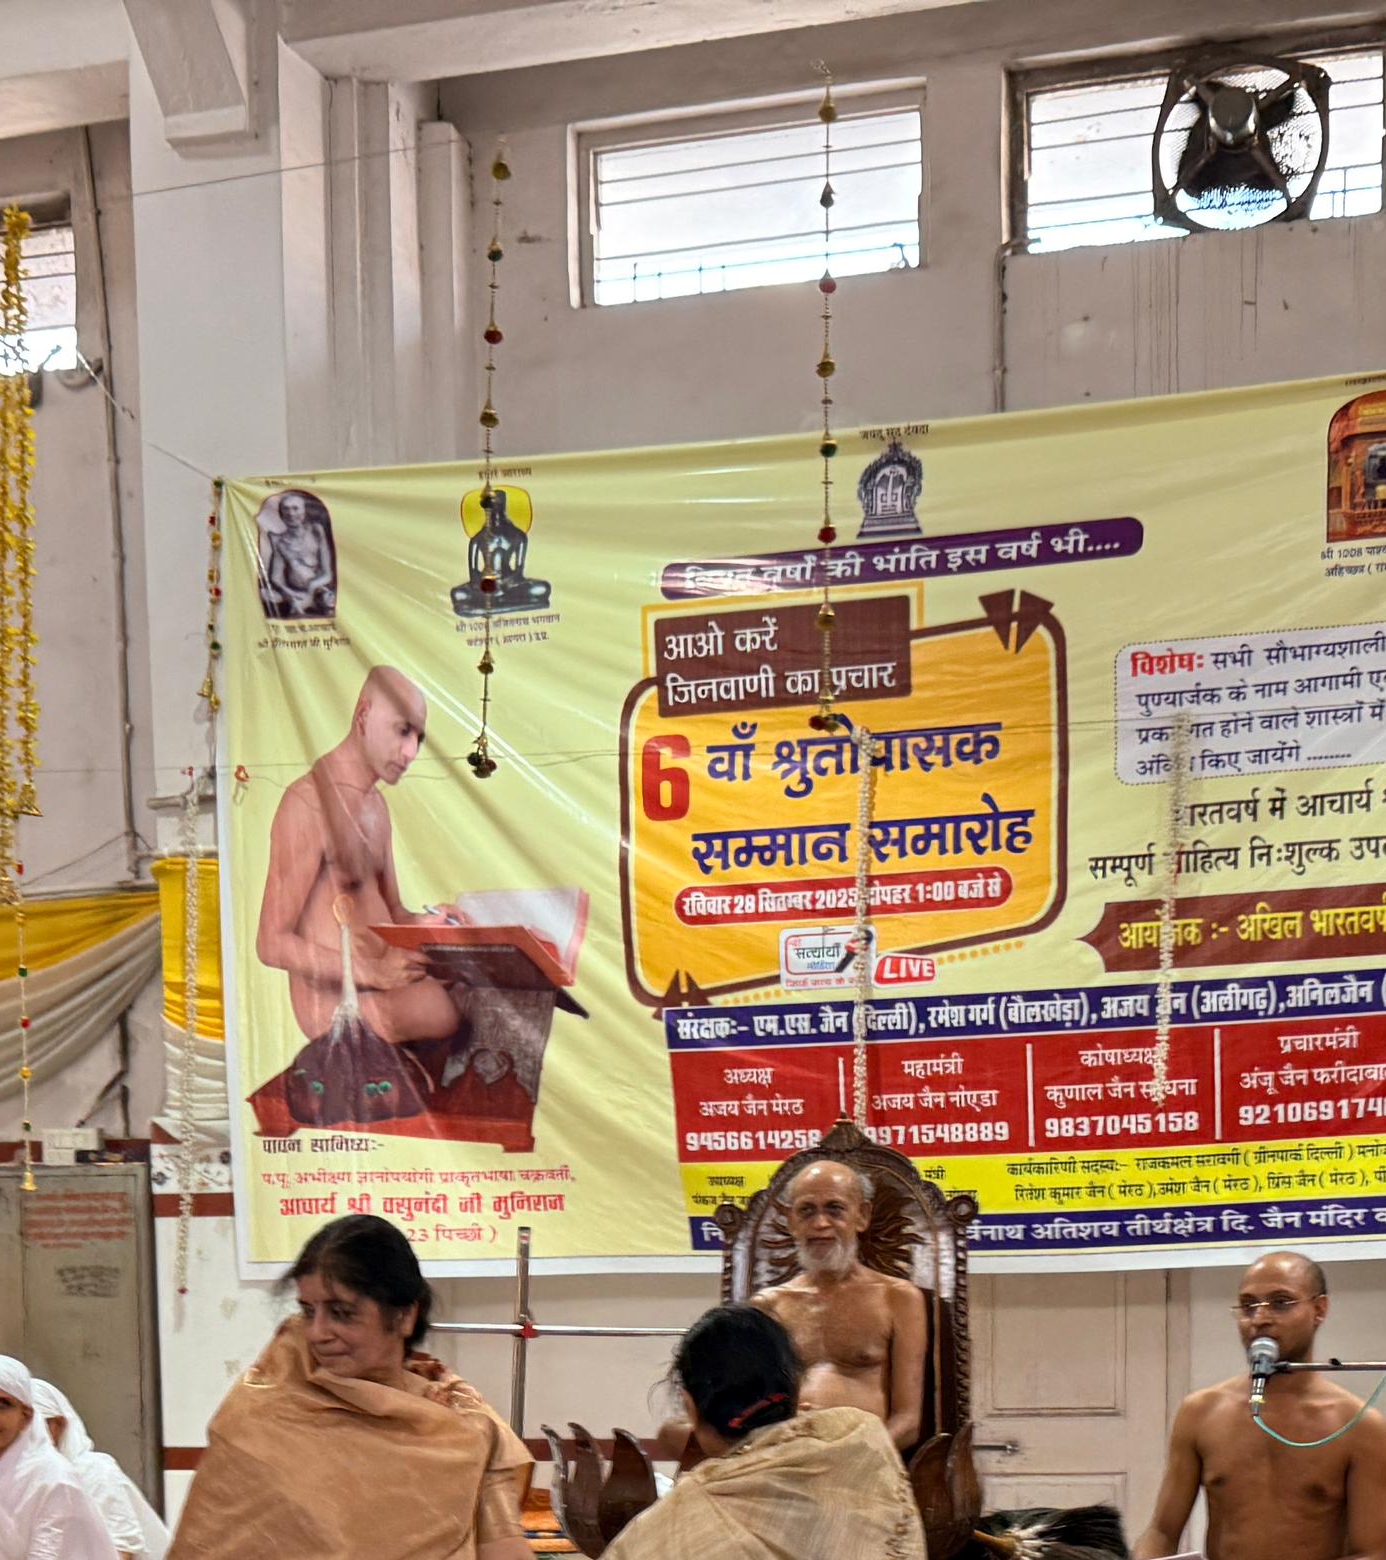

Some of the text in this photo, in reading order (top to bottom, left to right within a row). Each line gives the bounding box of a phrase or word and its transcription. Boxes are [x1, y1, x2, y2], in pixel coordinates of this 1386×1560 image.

[871, 545, 941, 573] भांति
[945, 543, 990, 573] इस
[995, 531, 1043, 562] वर्ष
[663, 616, 779, 660] आओ करें
[1210, 643, 1254, 671] सभी
[666, 662, 898, 707] जिनवाणी का प्रचार
[1135, 681, 1223, 717] पुण्यार्जक
[1226, 678, 1249, 703] के
[1253, 680, 1289, 700] नाम
[1294, 666, 1364, 693] आगामी
[1221, 711, 1254, 739] होने
[1258, 706, 1300, 731] वाले
[1368, 697, 1386, 722] में
[642, 733, 692, 822] 6
[705, 720, 759, 783] वाँ
[1200, 748, 1243, 773] किए
[1268, 787, 1287, 820] में
[1296, 777, 1374, 817] आचार्य
[691, 792, 1037, 876] सम्मान समारोह
[1088, 842, 1156, 887] सम्पूर्ण
[681, 890, 733, 917] रविवार
[733, 893, 756, 915] 28
[815, 886, 860, 910] 2025
[915, 880, 956, 903] 1:00
[1236, 900, 1306, 942] अखिल
[882, 956, 934, 980] LIVE
[818, 1005, 849, 1034] जैन
[927, 999, 967, 1029] रमेश
[967, 996, 996, 1026] गर्ग
[1100, 993, 1151, 1019] अजय
[1277, 1024, 1362, 1054] प्रचारमंत्री
[723, 1066, 775, 1089] अध्यक्ष
[901, 1050, 965, 1079] महामंत्री
[1239, 1065, 1279, 1096] अंजू
[1277, 1061, 1310, 1087] जैन
[699, 1092, 805, 1117] अजय जैन मेरठ
[872, 1083, 1000, 1112] अजय जैन नोएडा
[1043, 1074, 1136, 1109] कुणाल जैन
[1044, 1111, 1201, 1139] 9837045158
[262, 1138, 302, 1154] पावन
[279, 1190, 566, 1222] आचार्य श्री वसुनंदी जी मुनिराज
[1049, 1185, 1083, 1206] कुमार
[1084, 1180, 1106, 1200] जैन
[1189, 1174, 1211, 1194] जैन
[1294, 1169, 1318, 1189] जैन
[1030, 1216, 1122, 1241] अतिशय
[1124, 1209, 1216, 1238] तीर्थक्षेत्र
[1219, 1208, 1256, 1234] दि.
[1258, 1204, 1303, 1230] जैन
[1305, 1202, 1370, 1230] मंदिर
